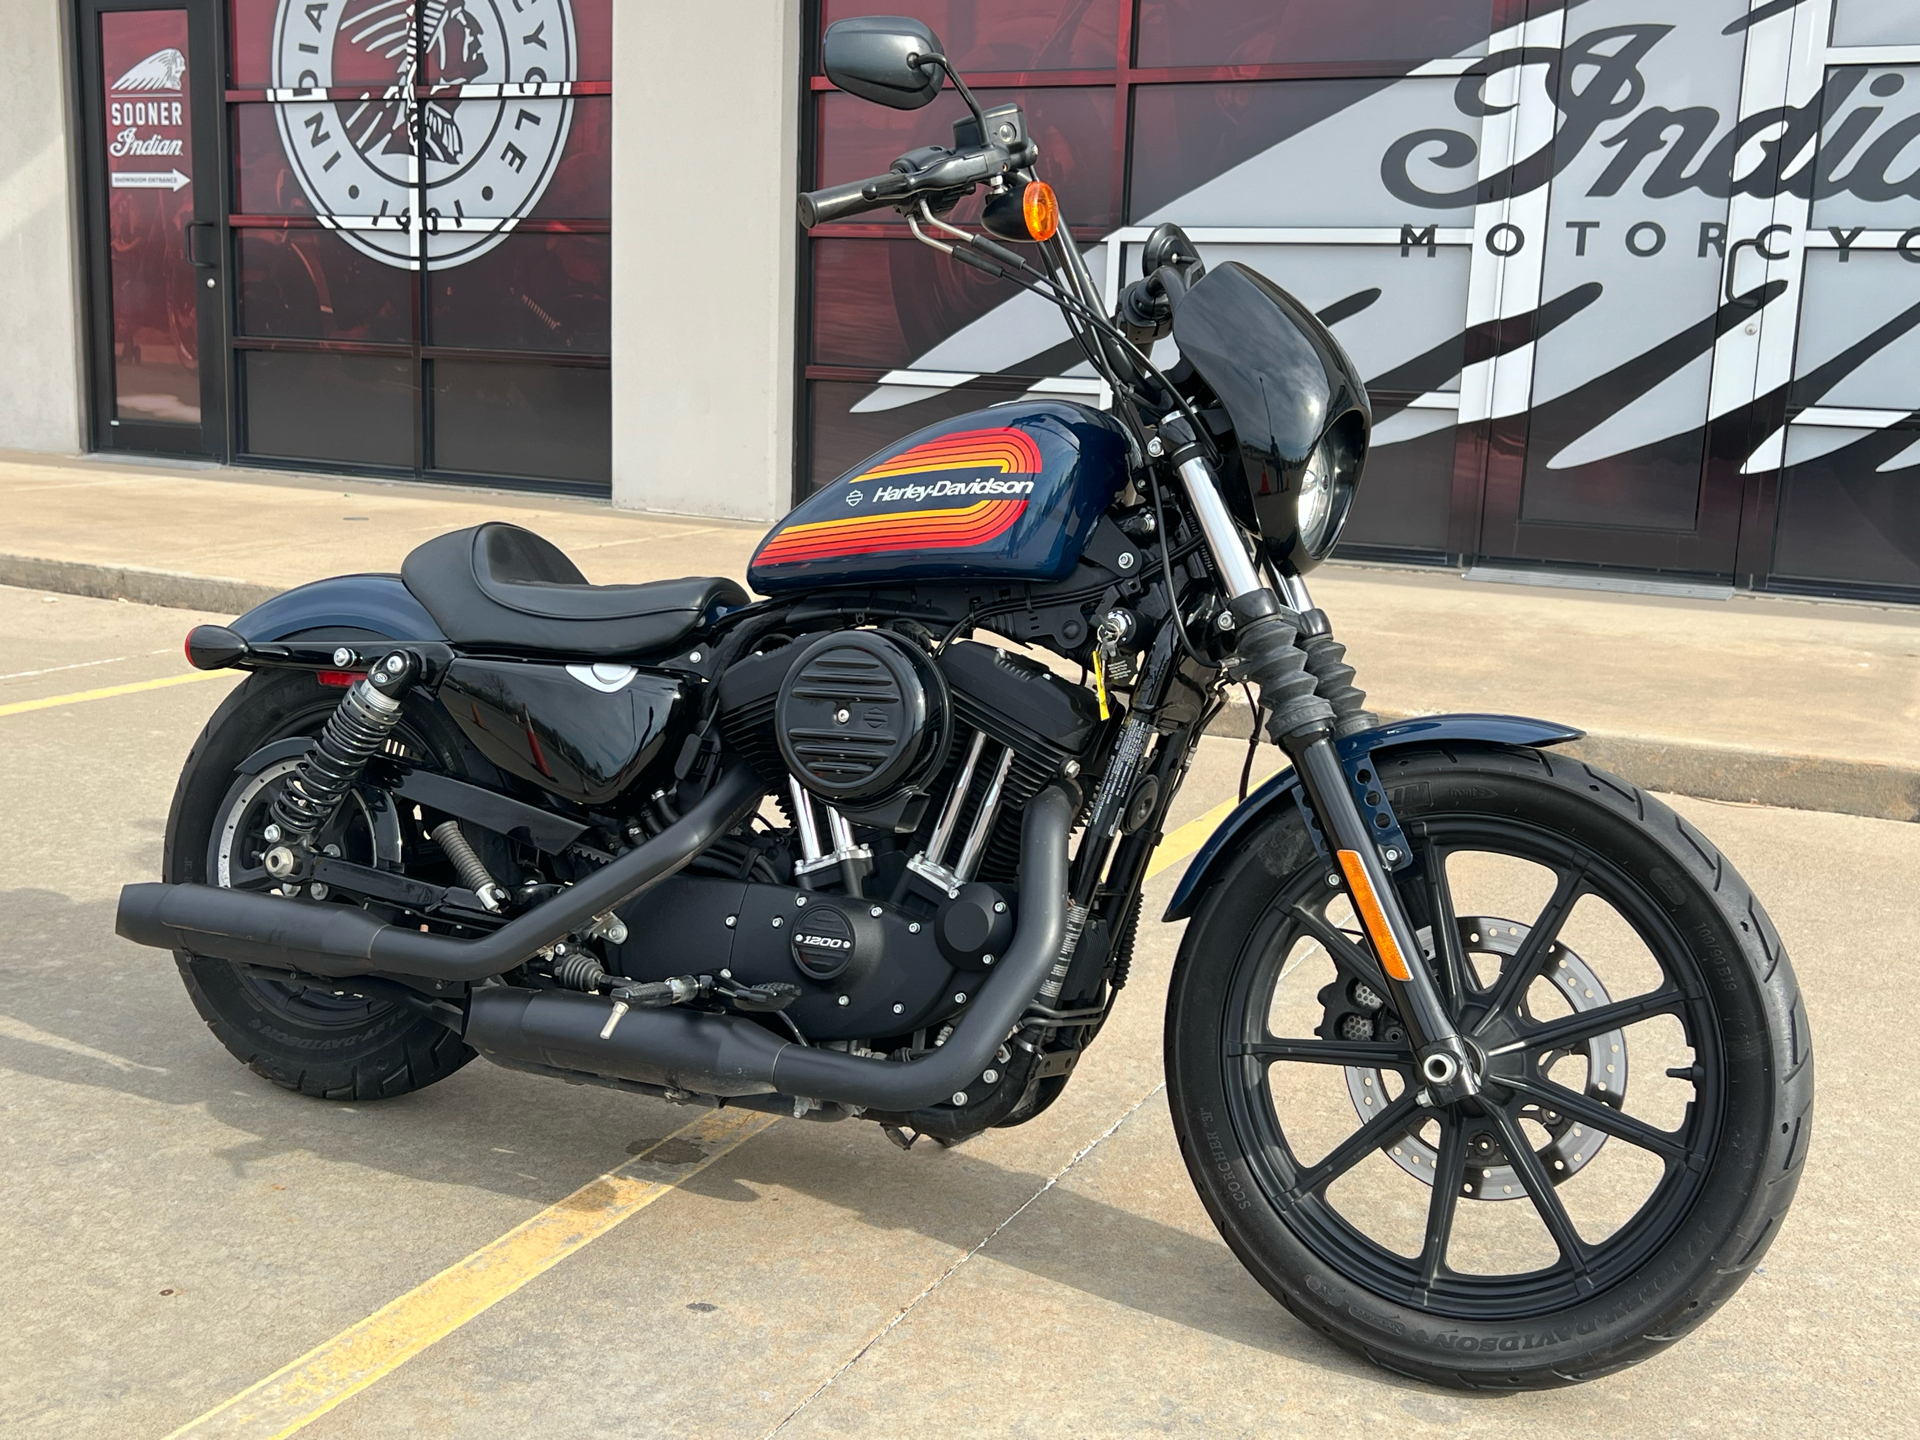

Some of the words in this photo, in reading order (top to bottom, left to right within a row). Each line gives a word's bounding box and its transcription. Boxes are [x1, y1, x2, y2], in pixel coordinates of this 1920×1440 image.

[111, 102, 182, 126] SOONER
[110, 127, 182, 157] Indian
[872, 478, 1034, 502] Harley-Davidson
[803, 935, 843, 949] 1200
[1207, 1131, 1251, 1210] SCORCHER
